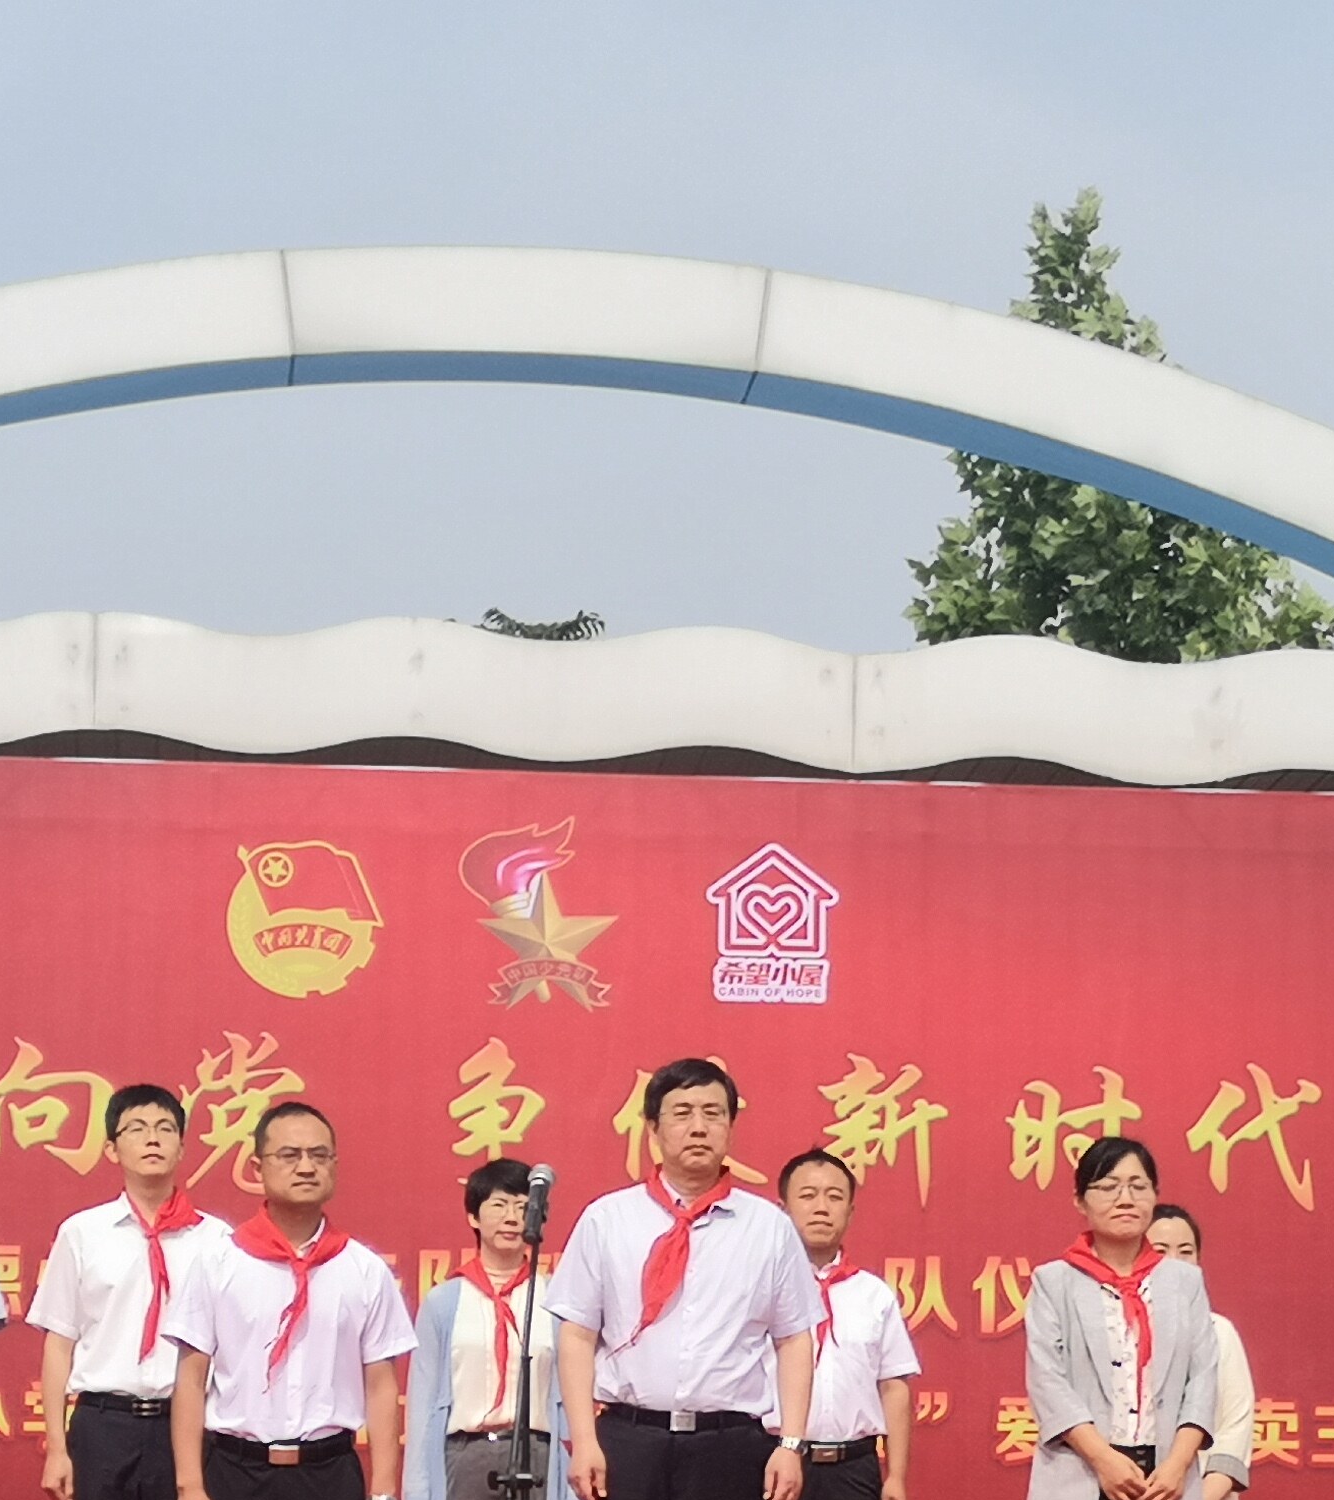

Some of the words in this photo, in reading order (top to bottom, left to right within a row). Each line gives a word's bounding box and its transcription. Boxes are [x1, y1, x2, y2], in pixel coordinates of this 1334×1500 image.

[718, 961, 824, 987] 希望小屋
[718, 987, 760, 997] CABIN
[764, 987, 781, 998] OF
[786, 987, 822, 999] HOPE
